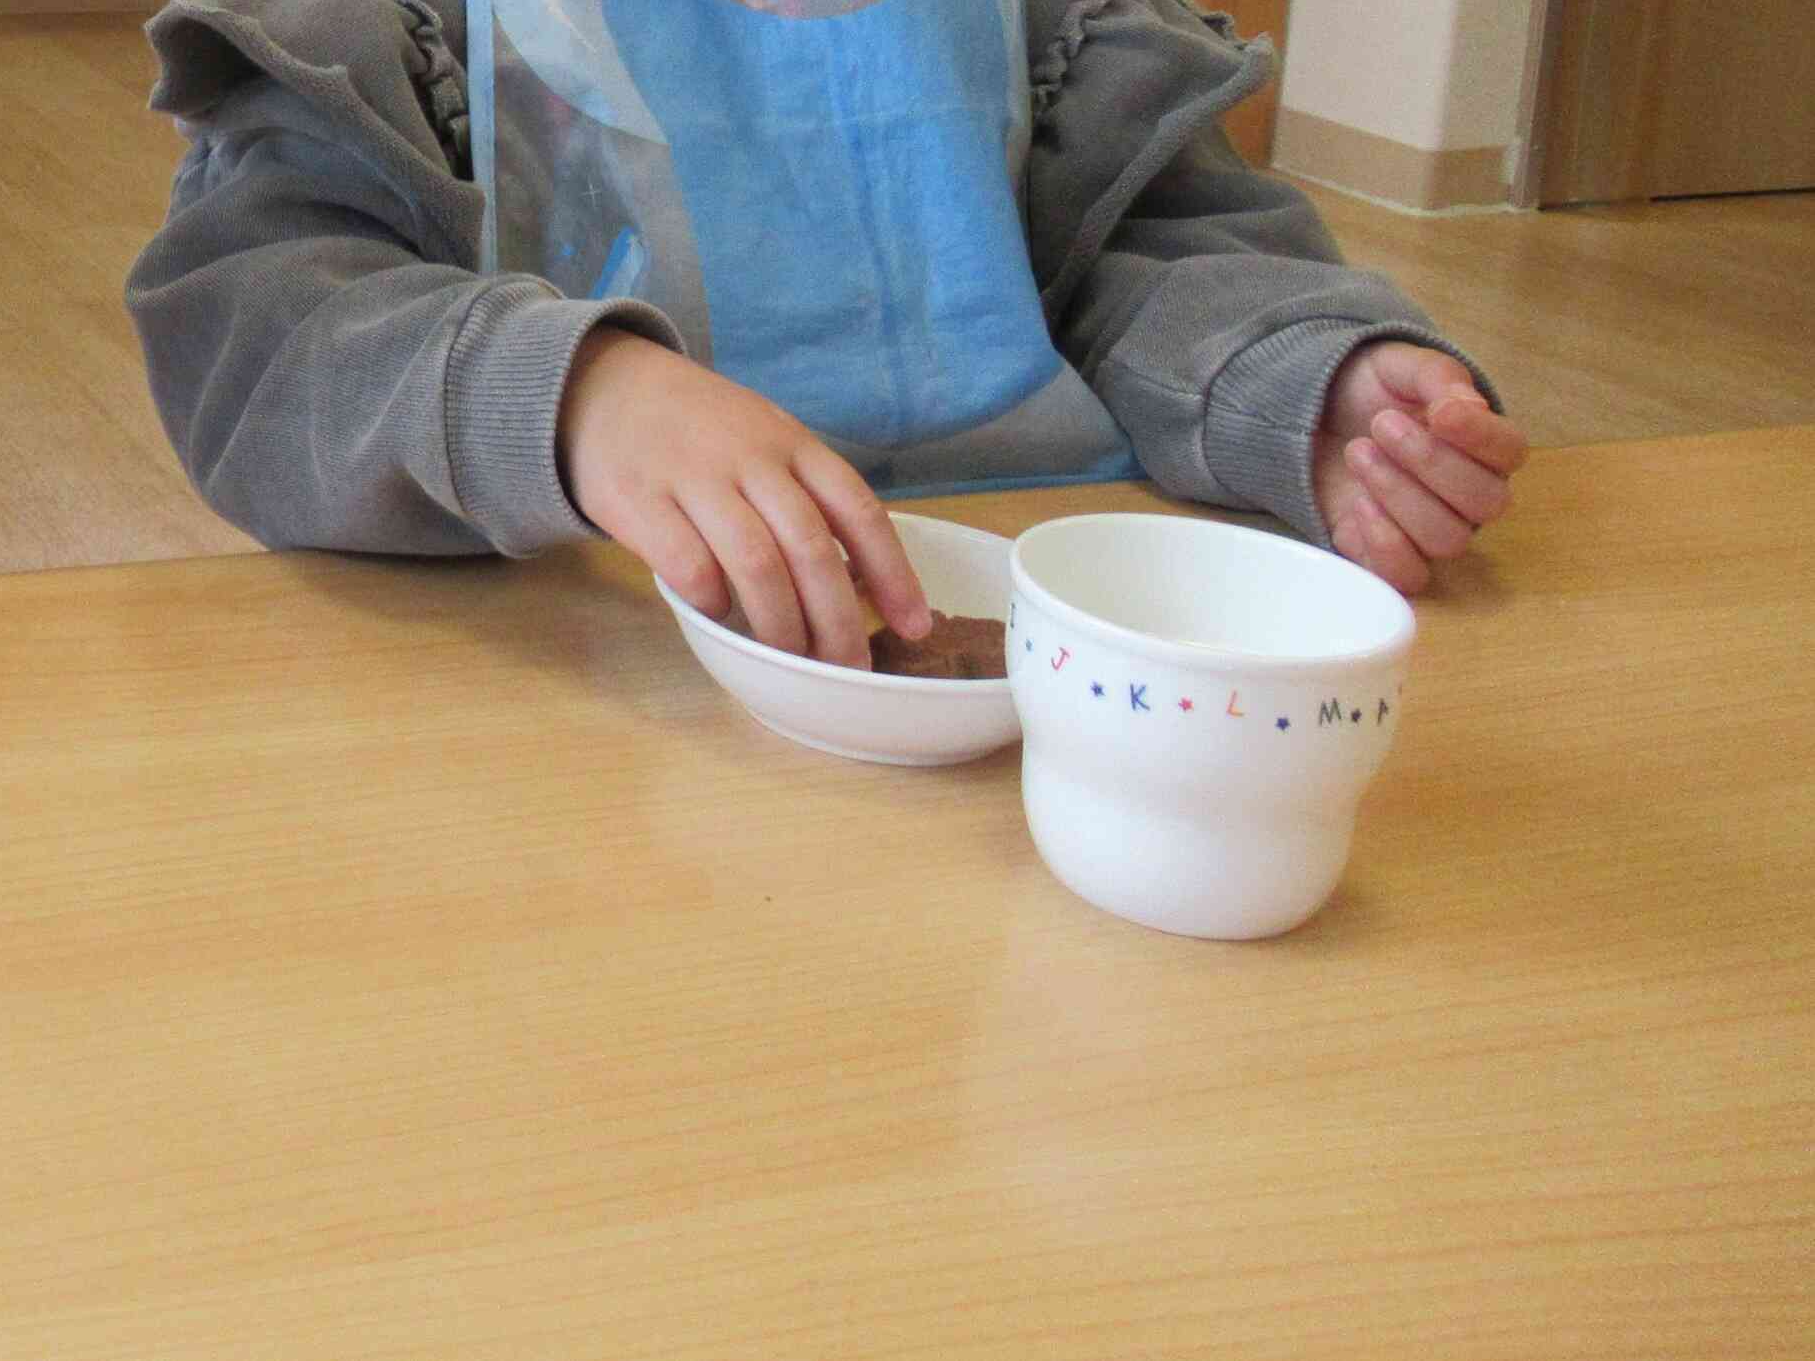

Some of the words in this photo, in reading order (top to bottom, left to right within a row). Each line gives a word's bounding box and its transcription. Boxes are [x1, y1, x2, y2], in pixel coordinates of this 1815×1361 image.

[1050, 646, 1071, 672] J
[1129, 682, 1151, 712] K
[1225, 689, 1245, 718] L
[1318, 696, 1343, 727] M
